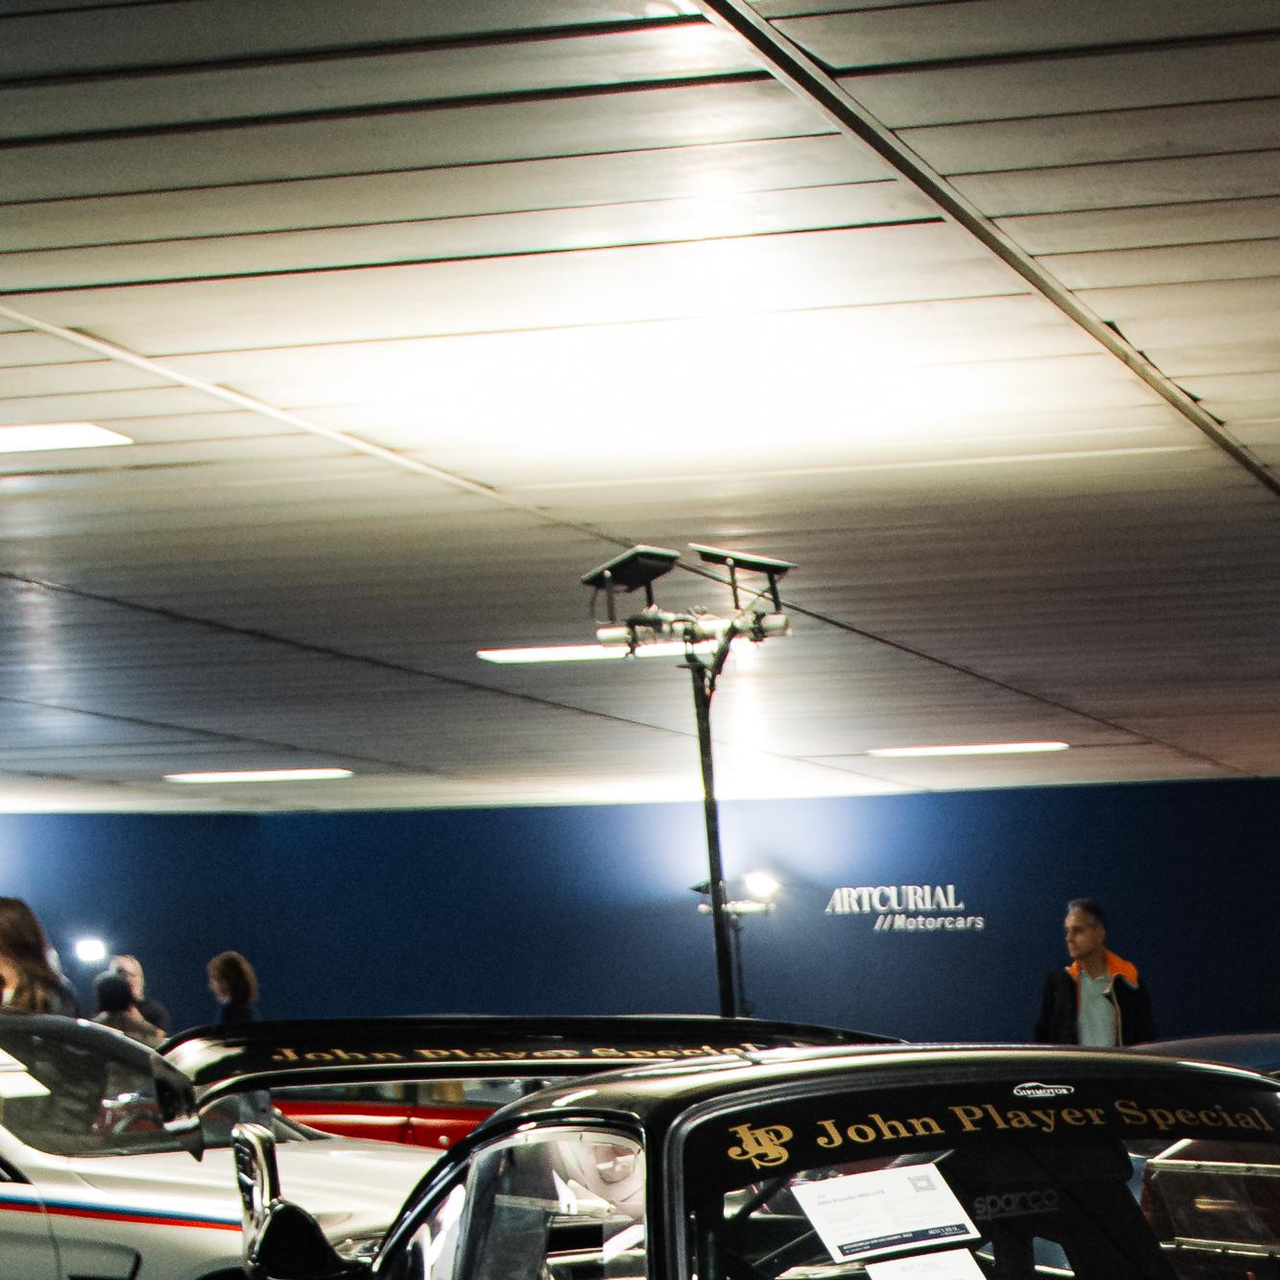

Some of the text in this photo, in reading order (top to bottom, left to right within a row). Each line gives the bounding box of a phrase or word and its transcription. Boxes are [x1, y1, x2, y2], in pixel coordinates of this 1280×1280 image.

[825, 885, 965, 914] ARTCURIAL
[816, 1113, 946, 1149] John
[949, 1103, 1107, 1133] Player
[1114, 1099, 1274, 1132] Special
[973, 1188, 1059, 1220] sparco
